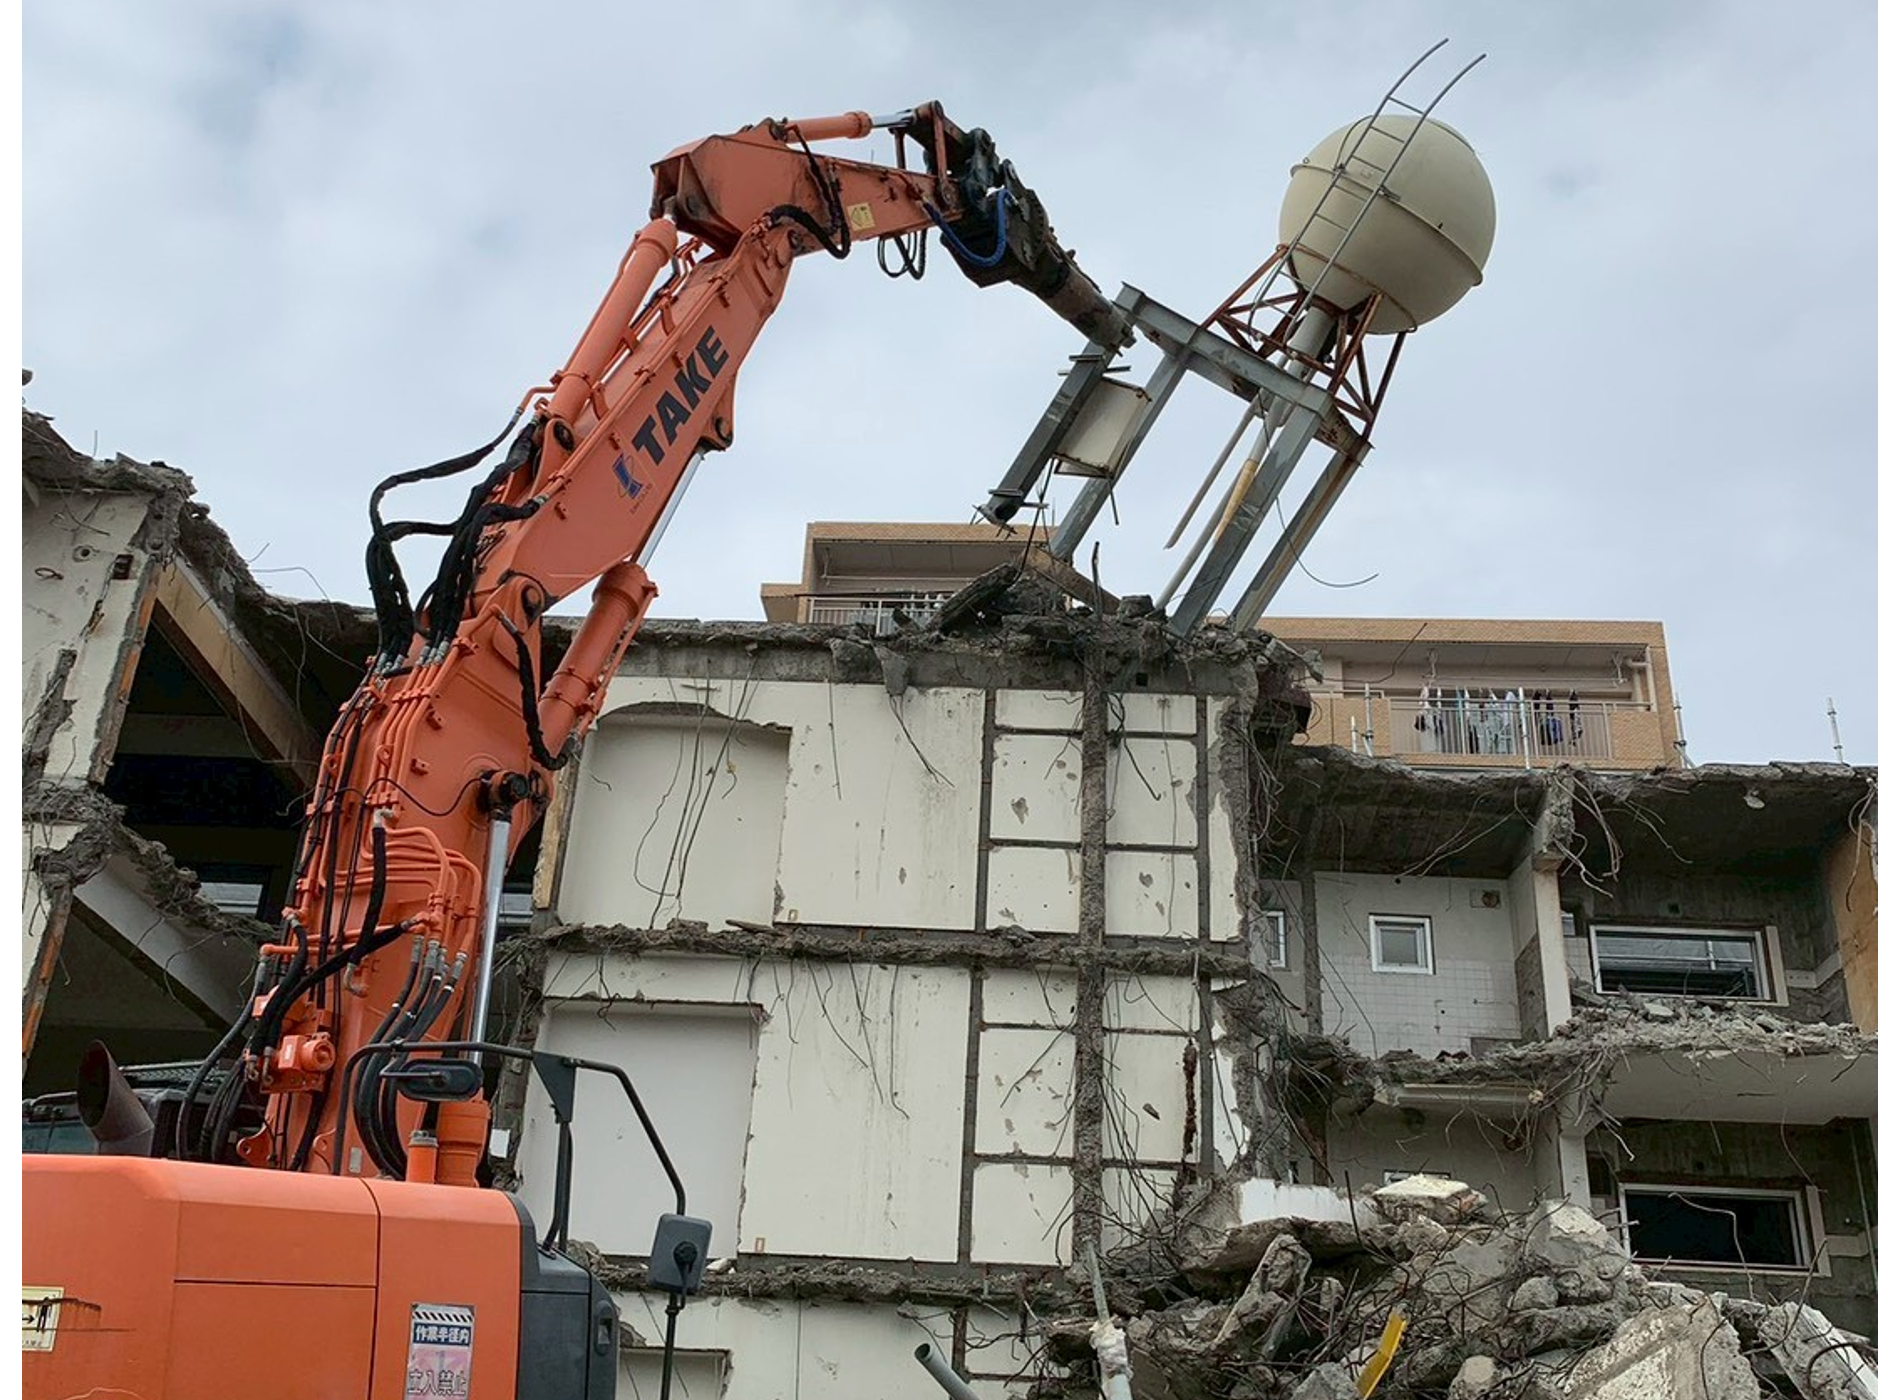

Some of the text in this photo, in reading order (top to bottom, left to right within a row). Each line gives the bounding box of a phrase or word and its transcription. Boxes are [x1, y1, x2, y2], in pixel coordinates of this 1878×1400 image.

[632, 326, 729, 466] TAKE
[415, 1325, 470, 1343] 作業半径内
[407, 1368, 467, 1396] 立入禁止
